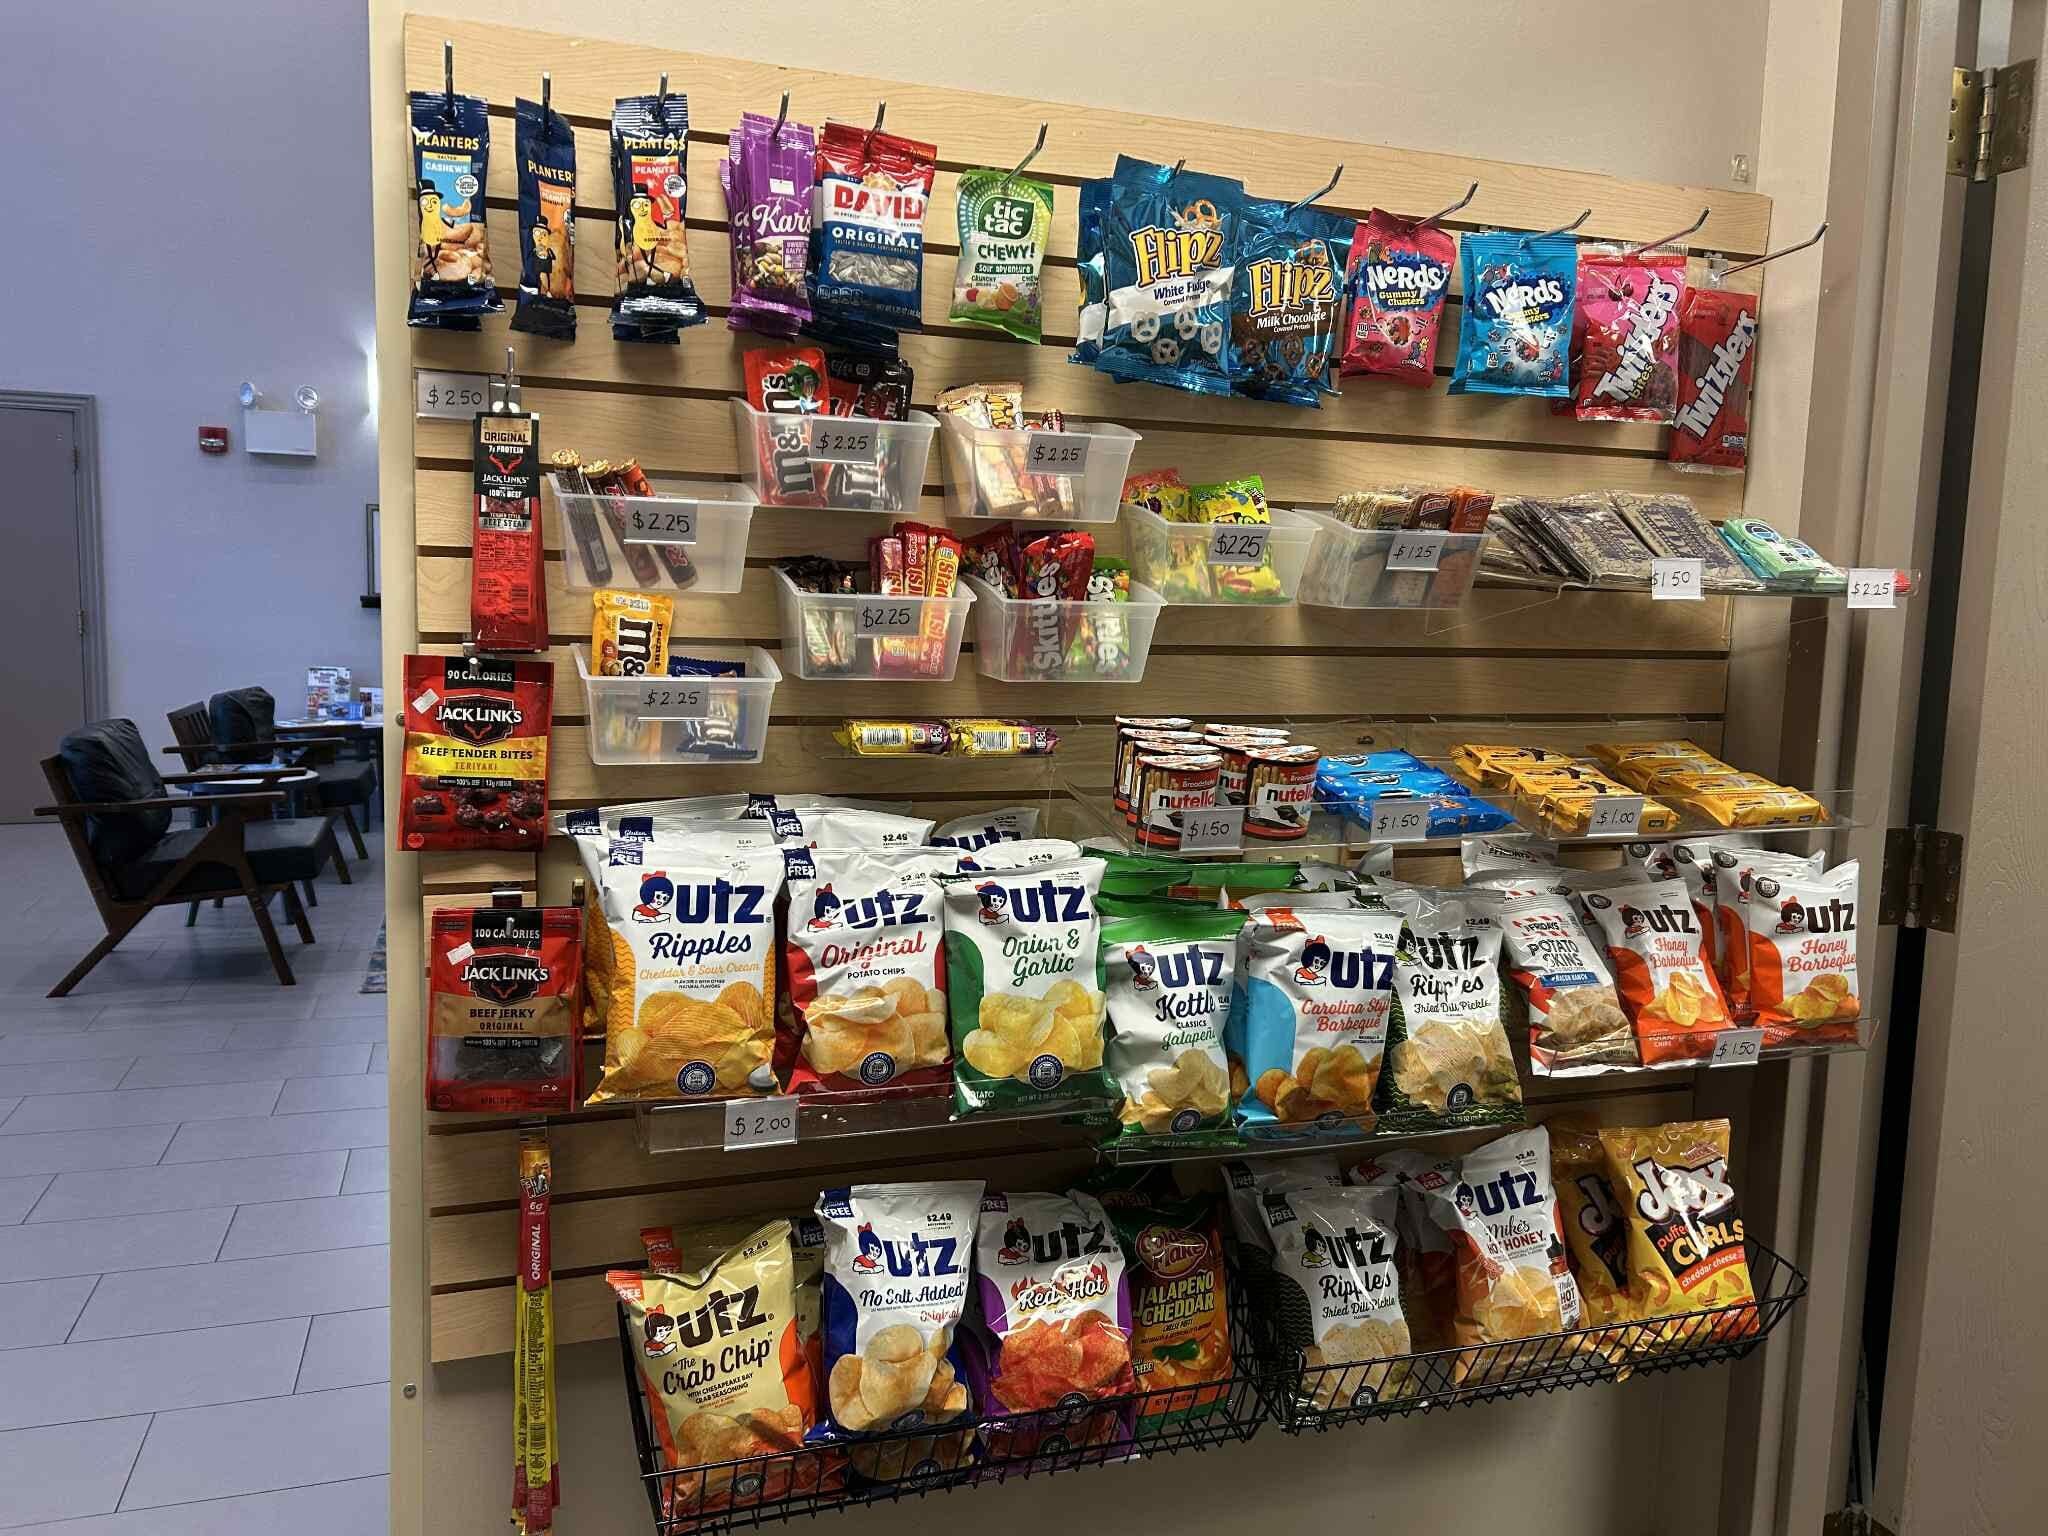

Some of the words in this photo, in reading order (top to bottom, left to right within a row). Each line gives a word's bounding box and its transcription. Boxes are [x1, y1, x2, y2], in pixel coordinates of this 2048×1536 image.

[415, 134, 480, 150] PLANTERS
[624, 138, 686, 151] PLANTERS
[425, 162, 470, 174] CASHEWS
[635, 165, 676, 175] PEANUTS
[834, 184, 924, 221] DAVID
[993, 201, 1025, 221] tic
[984, 213, 1024, 236] tac
[832, 226, 920, 250] ORIGINAL
[977, 242, 1036, 261] CHEWY!
[1131, 228, 1223, 288] Flipz
[1249, 260, 1334, 315] Flipz
[1367, 265, 1445, 292] Nerds
[1154, 285, 1184, 301] White
[1186, 279, 1211, 297] Fudge
[1379, 290, 1417, 300] Gummy
[1163, 296, 1186, 306] Covered
[1388, 297, 1425, 306] Clusters
[1256, 315, 1280, 329] Milk
[1282, 310, 1327, 326] Chocolate
[1274, 325, 1293, 333] Covered
[1294, 323, 1311, 331] Pretzels
[484, 431, 528, 443] ORIGINAL
[496, 446, 524, 454] PROTEIN
[482, 474, 503, 483] JACK
[489, 488, 505, 498] 100%
[483, 518, 502, 528] BEEF
[504, 518, 528, 529] STEAK
[632, 509, 692, 534] $2.25
[447, 670, 460, 680] 90
[462, 670, 513, 682] CALORIES
[436, 706, 475, 722] JACK
[422, 746, 449, 757] BEEF
[451, 748, 497, 759] TENDER
[500, 750, 533, 760] BITES
[455, 761, 498, 771] TERIYAKI
[1158, 791, 1215, 807] nutella
[776, 823, 803, 836] FREE
[882, 833, 908, 843] $2.49
[612, 854, 641, 866] FREE
[787, 864, 816, 878] FREE
[475, 929, 492, 939] 100
[493, 929, 540, 940] CAORIES
[1003, 934, 1063, 958] Onion
[1067, 928, 1081, 950] &
[1373, 931, 1394, 942] $2.49
[649, 930, 752, 966] Ripples
[821, 931, 927, 969] Original
[1528, 939, 1580, 957] POTATO
[1655, 936, 1688, 958] Honey
[1801, 938, 1848, 957] Honey
[1547, 952, 1588, 968] SKINS
[461, 966, 501, 982] JACK
[640, 967, 684, 980] Cheddar
[698, 964, 723, 977] Sour
[726, 961, 761, 974] Cream
[848, 969, 880, 979] POTATO
[882, 966, 907, 976] CHIPS
[1012, 956, 1075, 988] Garlic
[469, 1008, 497, 1018] BEEF
[499, 1008, 535, 1019] JERKY
[1155, 990, 1216, 1023] Kettle
[1302, 998, 1365, 1016] Carolina
[1413, 1003, 1439, 1014] Fried
[1441, 1003, 1458, 1013] Dill
[1459, 999, 1490, 1011] Pickle
[479, 1022, 525, 1031] ORIGINAL
[1176, 1020, 1208, 1029] CLASSICS
[1317, 1015, 1382, 1036] Barbeque
[729, 1117, 791, 1137] $2.00
[824, 1206, 853, 1218] FREE
[926, 1212, 952, 1222] $2.49
[1269, 1209, 1296, 1223] FREE
[1487, 1216, 1531, 1243] Mike's
[1657, 1223, 1690, 1252] puffe
[742, 1240, 769, 1257] $2.49
[1672, 1219, 1744, 1267] CURLS
[532, 1224, 542, 1281] ORIGINAL
[1682, 1262, 1713, 1288] cheddar
[1713, 1251, 1738, 1269] cheese
[860, 1288, 882, 1308] No
[886, 1286, 913, 1305] Salt
[914, 1281, 964, 1301] Added
[1018, 1283, 1059, 1311] Red
[1065, 1274, 1108, 1302] Hot
[1136, 1268, 1215, 1317] JALAPEÑO
[1319, 1271, 1392, 1304] Ripples
[1560, 1287, 1576, 1305] HOT
[1142, 1293, 1215, 1327] CHEDDAR
[1322, 1306, 1350, 1319] Fried
[1351, 1301, 1369, 1316] Dill
[663, 1359, 716, 1396] Crab
[687, 1390, 702, 1399] WITH
[702, 1377, 741, 1396] CHESAPEAKE
[741, 1372, 754, 1382] BAY
[695, 1394, 712, 1405] CRAB
[712, 1382, 750, 1401] SEASONING
